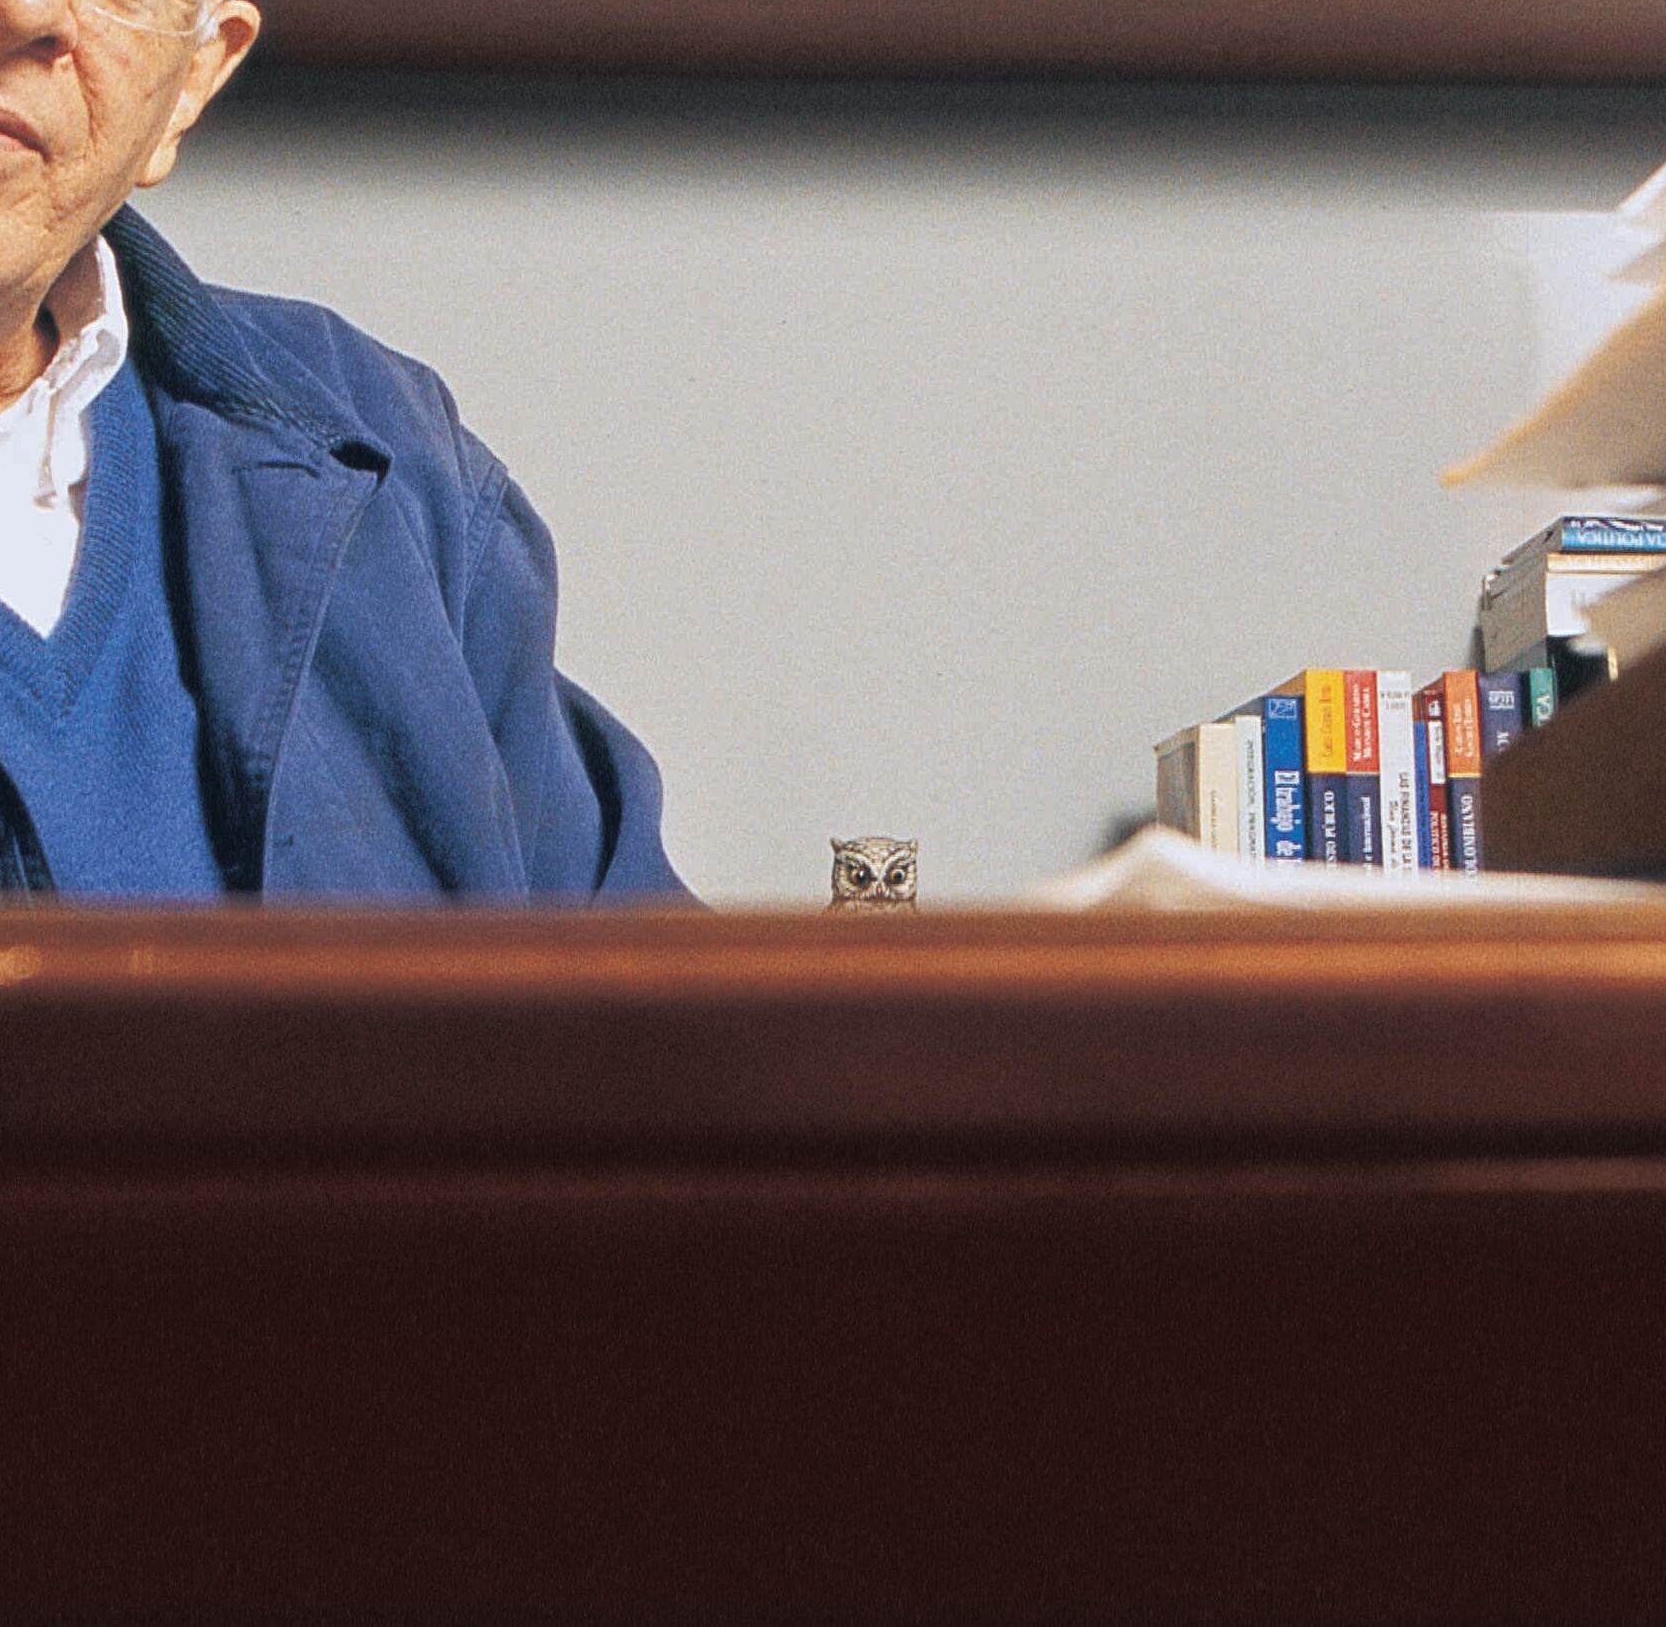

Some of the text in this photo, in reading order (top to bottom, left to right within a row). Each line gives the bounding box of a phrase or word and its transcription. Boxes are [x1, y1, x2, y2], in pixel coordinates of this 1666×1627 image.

[1271, 787, 1301, 831] trabajo
[1322, 789, 1337, 838] PÚBLICO
[1361, 797, 1373, 852] Internacional
[1277, 840, 1301, 856] de
